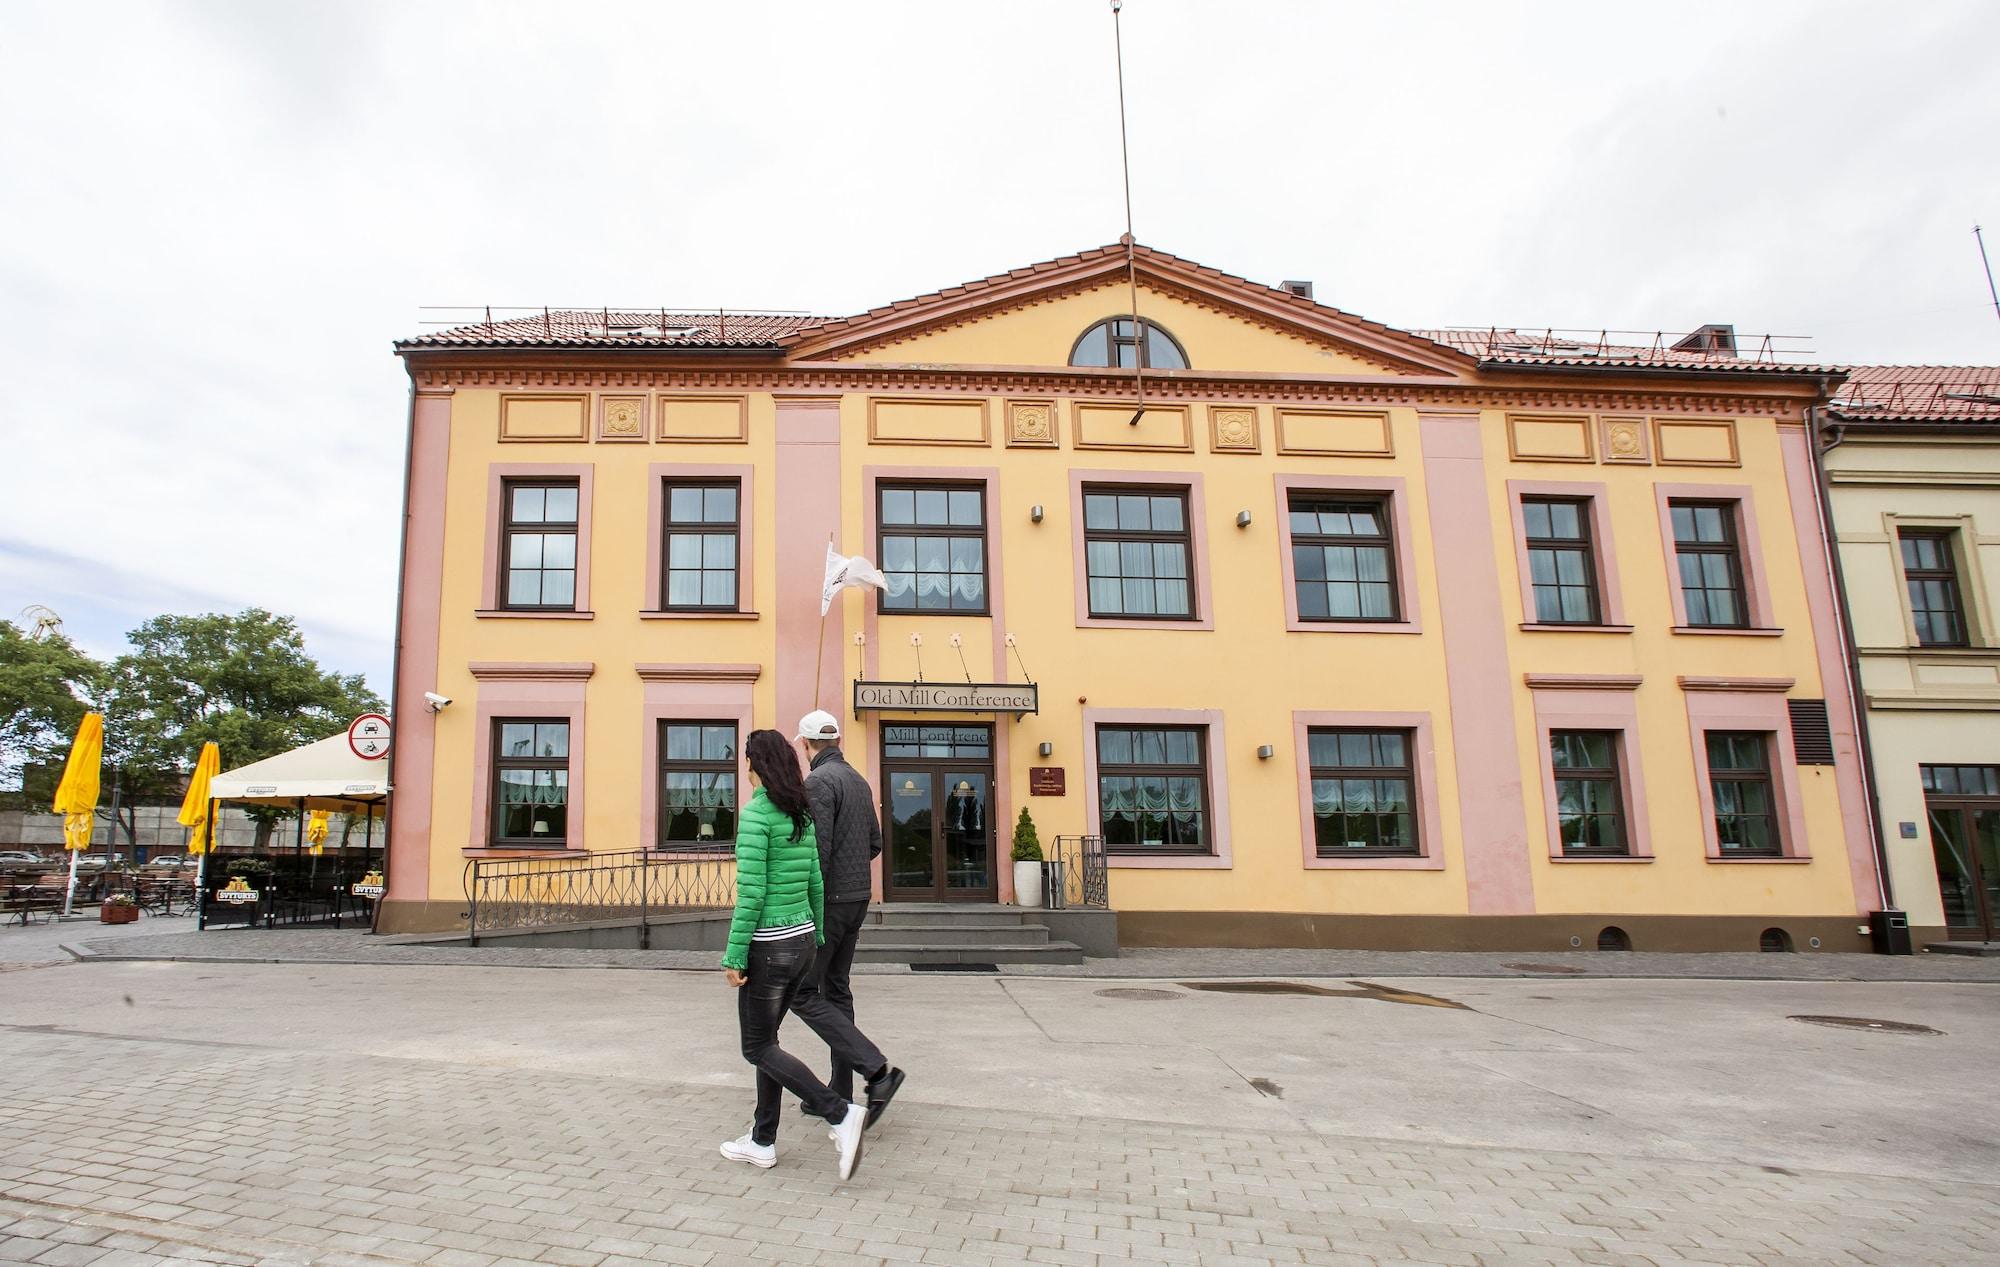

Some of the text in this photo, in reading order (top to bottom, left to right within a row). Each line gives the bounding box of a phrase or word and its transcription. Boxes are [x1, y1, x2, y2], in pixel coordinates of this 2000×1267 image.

[861, 689, 1031, 706] Old Mill Conference
[890, 728, 987, 742] Mill Conferenc
